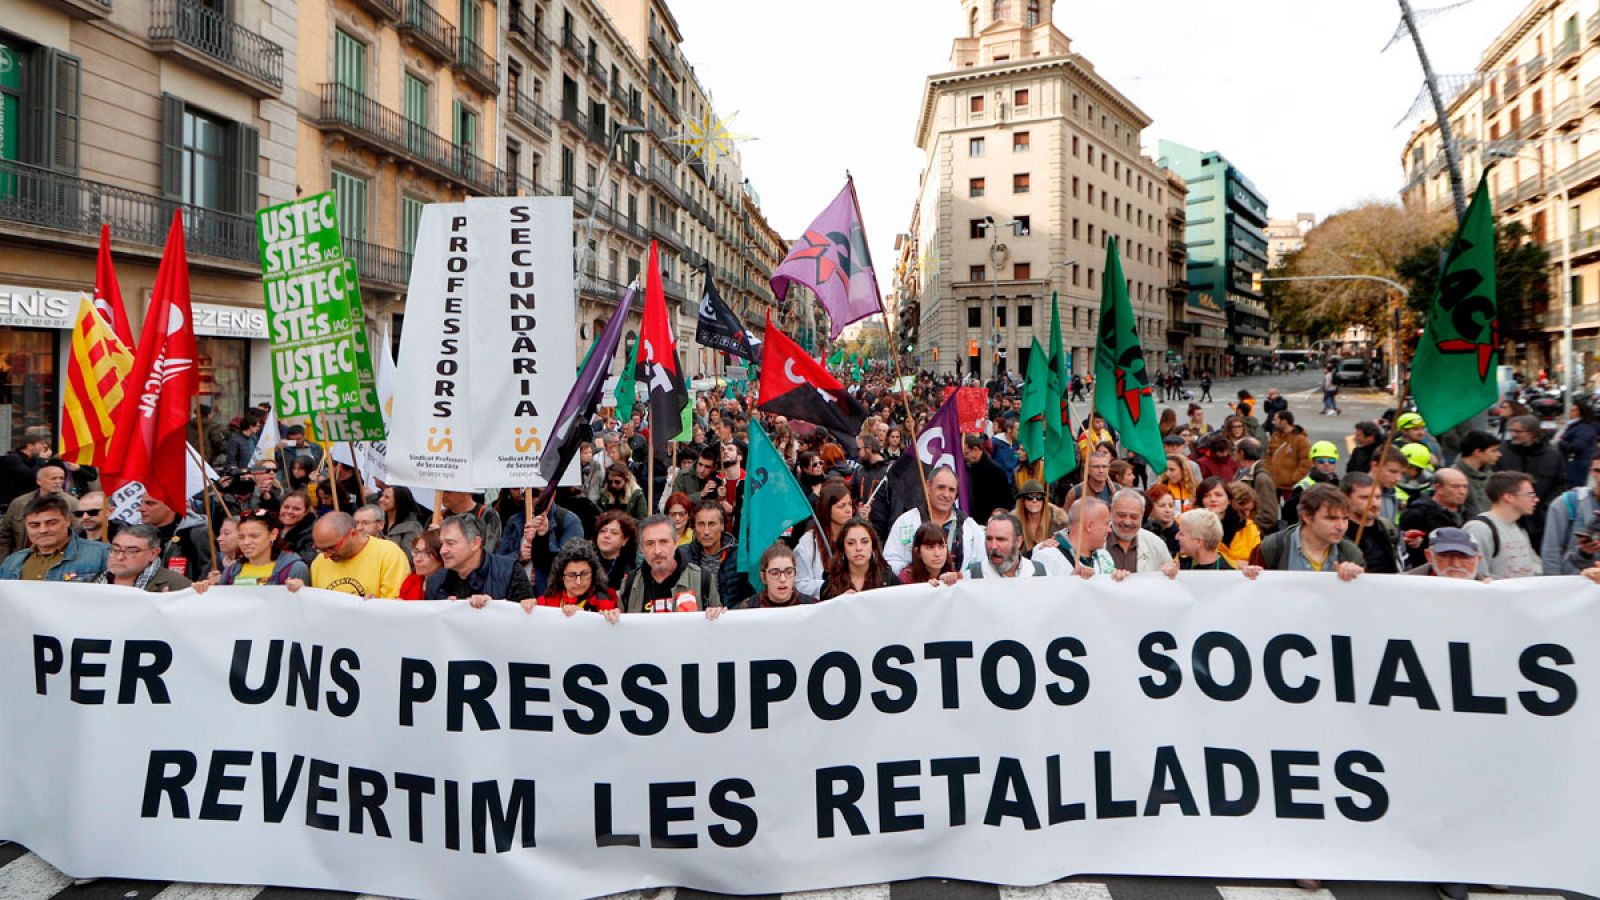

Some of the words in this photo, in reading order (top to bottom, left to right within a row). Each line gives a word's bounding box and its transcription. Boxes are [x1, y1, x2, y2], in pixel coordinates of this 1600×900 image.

[261, 195, 334, 244] USTEC
[323, 246, 340, 259] IAC
[268, 267, 344, 314] USTEC
[510, 206, 538, 417] SECUNDÀRIA
[333, 318, 349, 332] IAC
[433, 216, 468, 418] PROFESSORS
[275, 339, 353, 383] USTEC
[342, 390, 359, 404] IAC
[34, 635, 172, 705] PER
[229, 639, 361, 717] UNS
[400, 637, 1090, 736] PRESSUPOSTOS
[1139, 632, 1577, 717] SOCIALS
[141, 751, 536, 853] REVERTIM
[595, 779, 758, 848] LES
[816, 746, 1389, 838] RETALLADES
